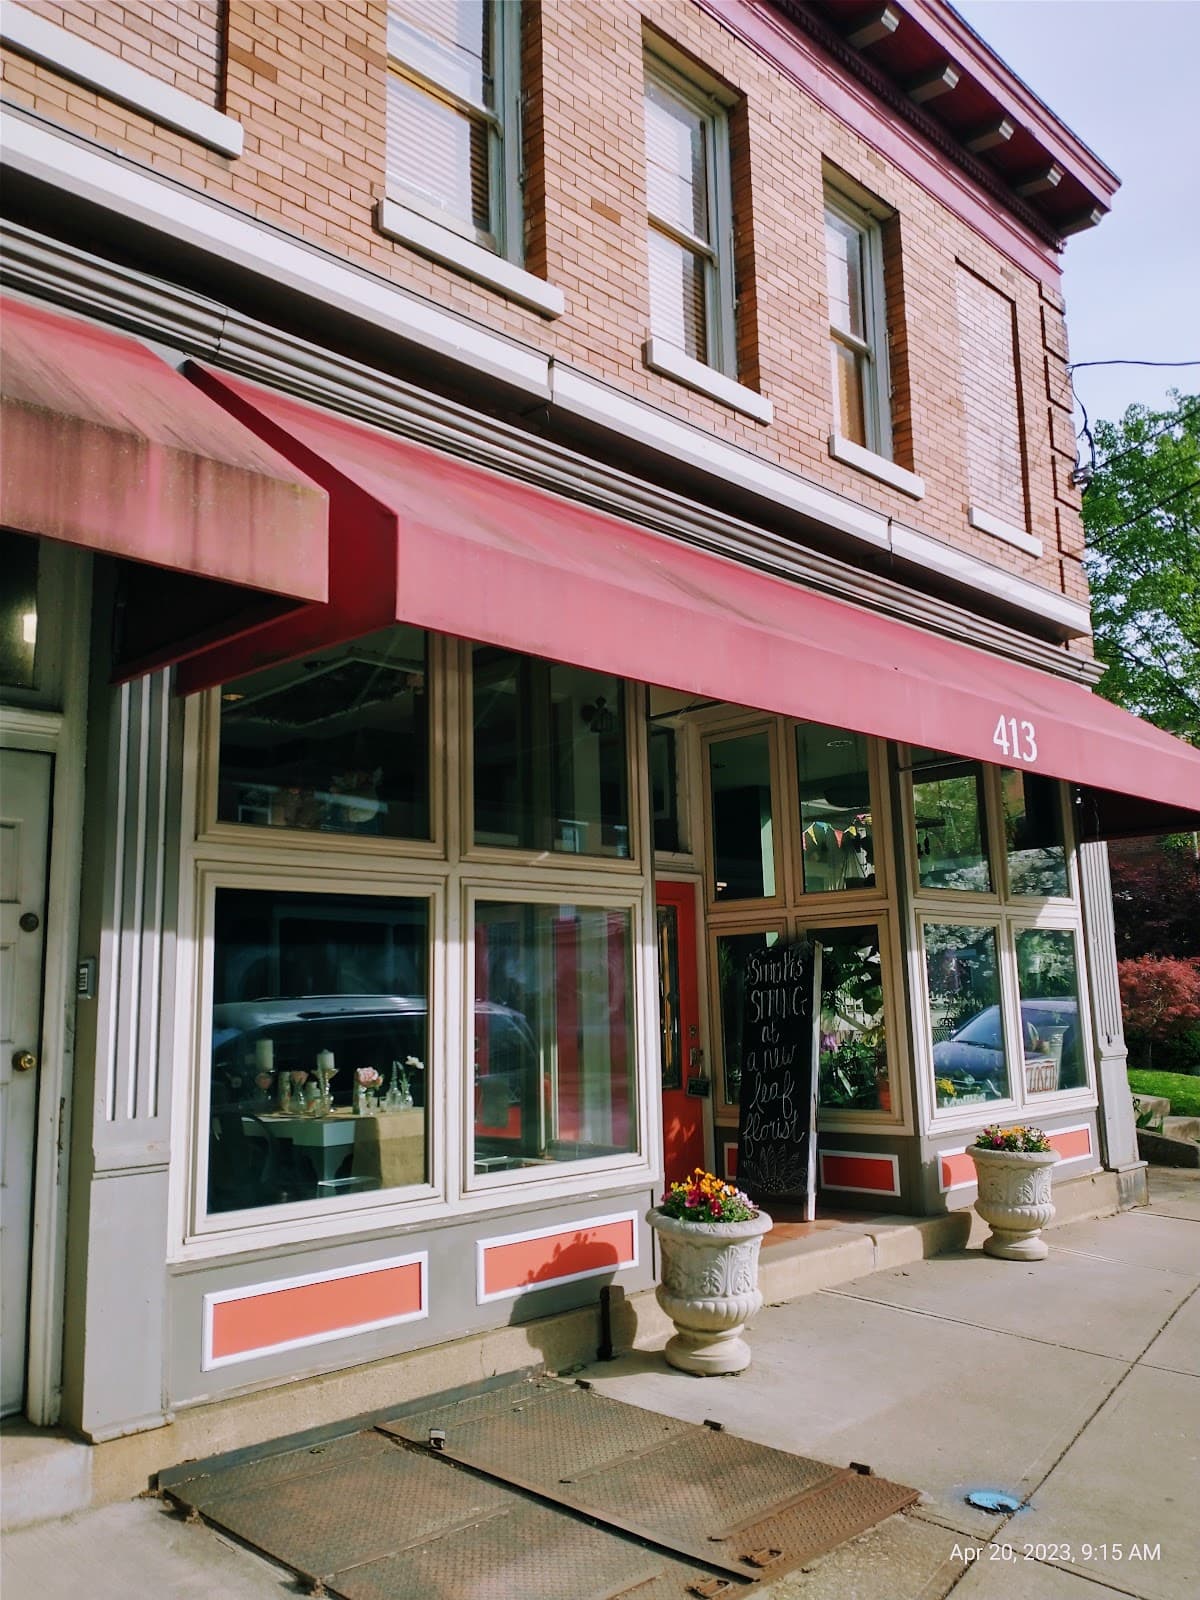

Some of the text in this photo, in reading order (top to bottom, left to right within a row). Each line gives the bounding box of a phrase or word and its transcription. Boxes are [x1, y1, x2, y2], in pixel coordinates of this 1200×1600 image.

[992, 714, 1038, 763] 413
[761, 1021, 780, 1043] at
[747, 1044, 797, 1073] a new
[749, 1070, 795, 1119] leaf
[742, 1109, 805, 1158] florist
